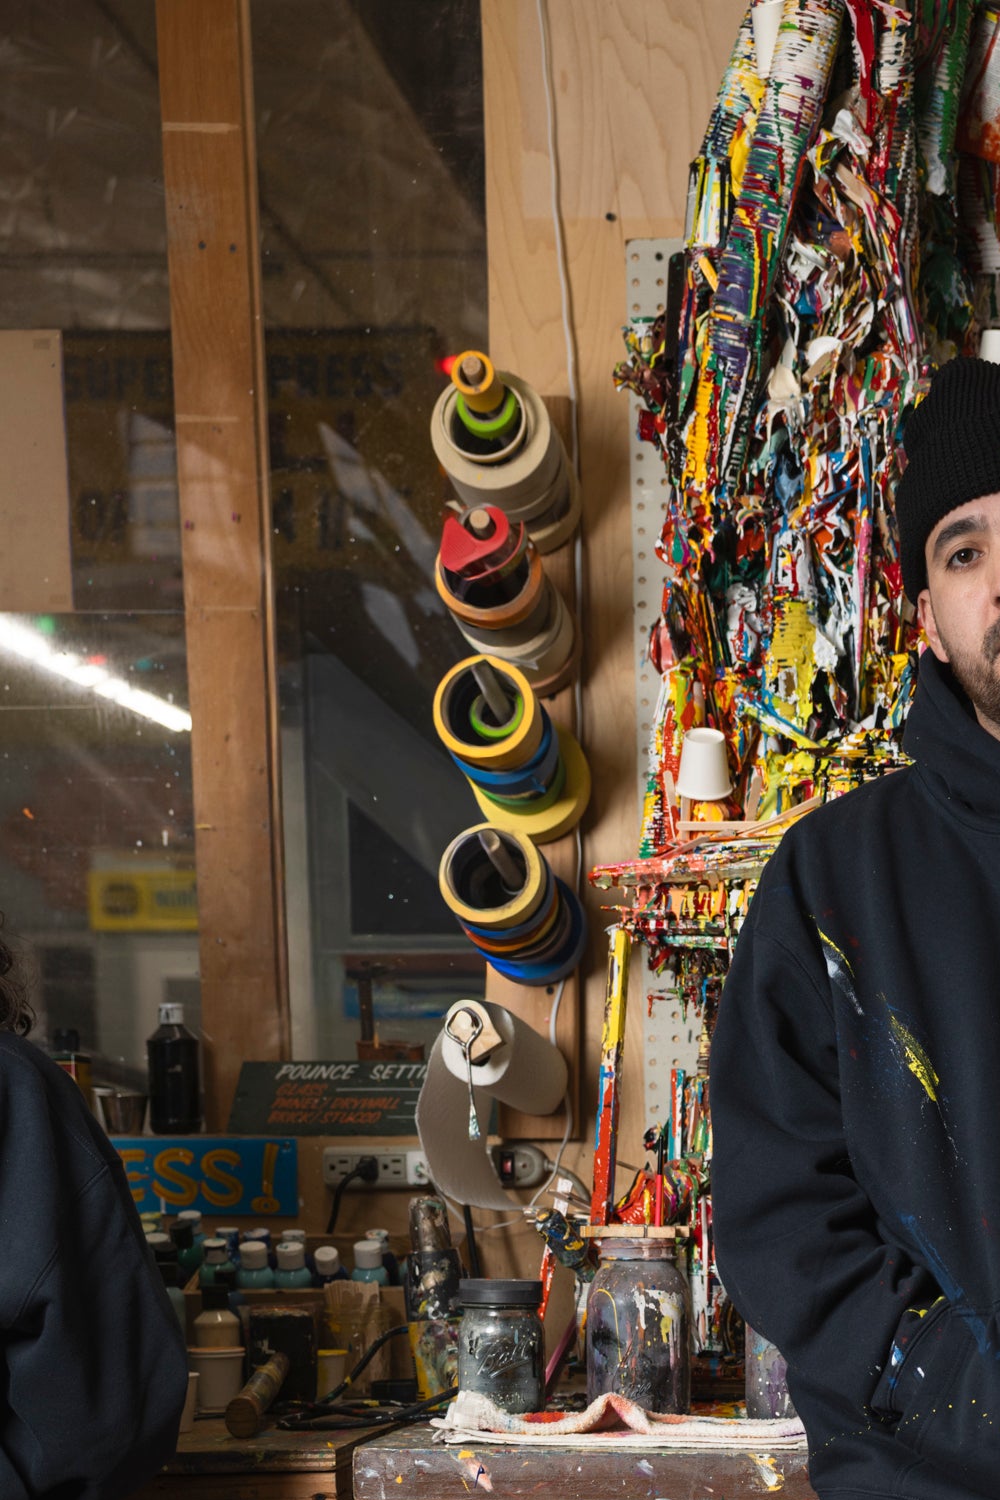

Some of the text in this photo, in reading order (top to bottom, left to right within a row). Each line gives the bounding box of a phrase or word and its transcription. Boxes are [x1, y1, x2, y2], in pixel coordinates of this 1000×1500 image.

[275, 1064, 429, 1080] POUNCE SETTI
[275, 1083, 328, 1096] GLASS
